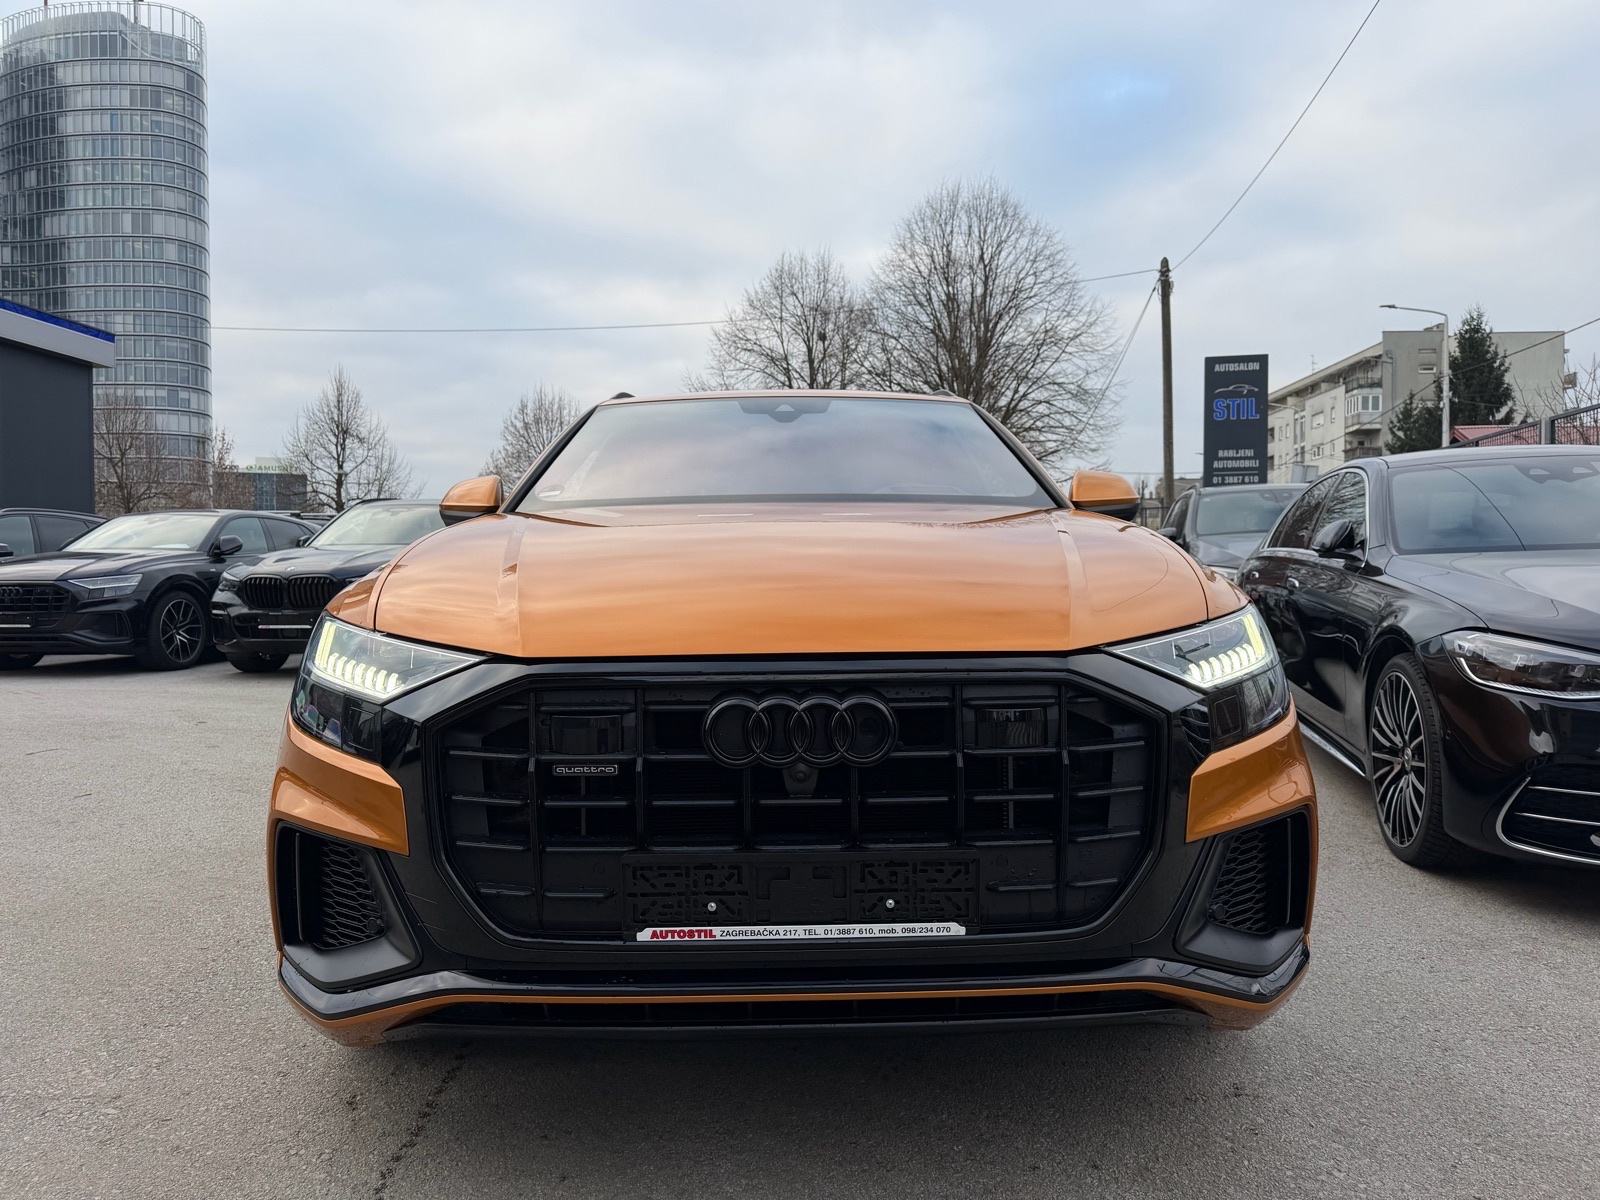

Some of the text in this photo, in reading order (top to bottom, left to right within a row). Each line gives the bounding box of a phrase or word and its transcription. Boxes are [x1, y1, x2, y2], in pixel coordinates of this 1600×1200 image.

[1214, 361, 1260, 372] AUTOSALON
[1213, 397, 1260, 421] STIL
[1213, 459, 1260, 468] AUTOMOBILI
[1212, 476, 1222, 484] 01
[556, 766, 615, 774] quattro
[650, 926, 951, 940] AUTOSTIL ZAGREBAČKA 217, TEL. 01/3887 610, mob. 098/234 070
